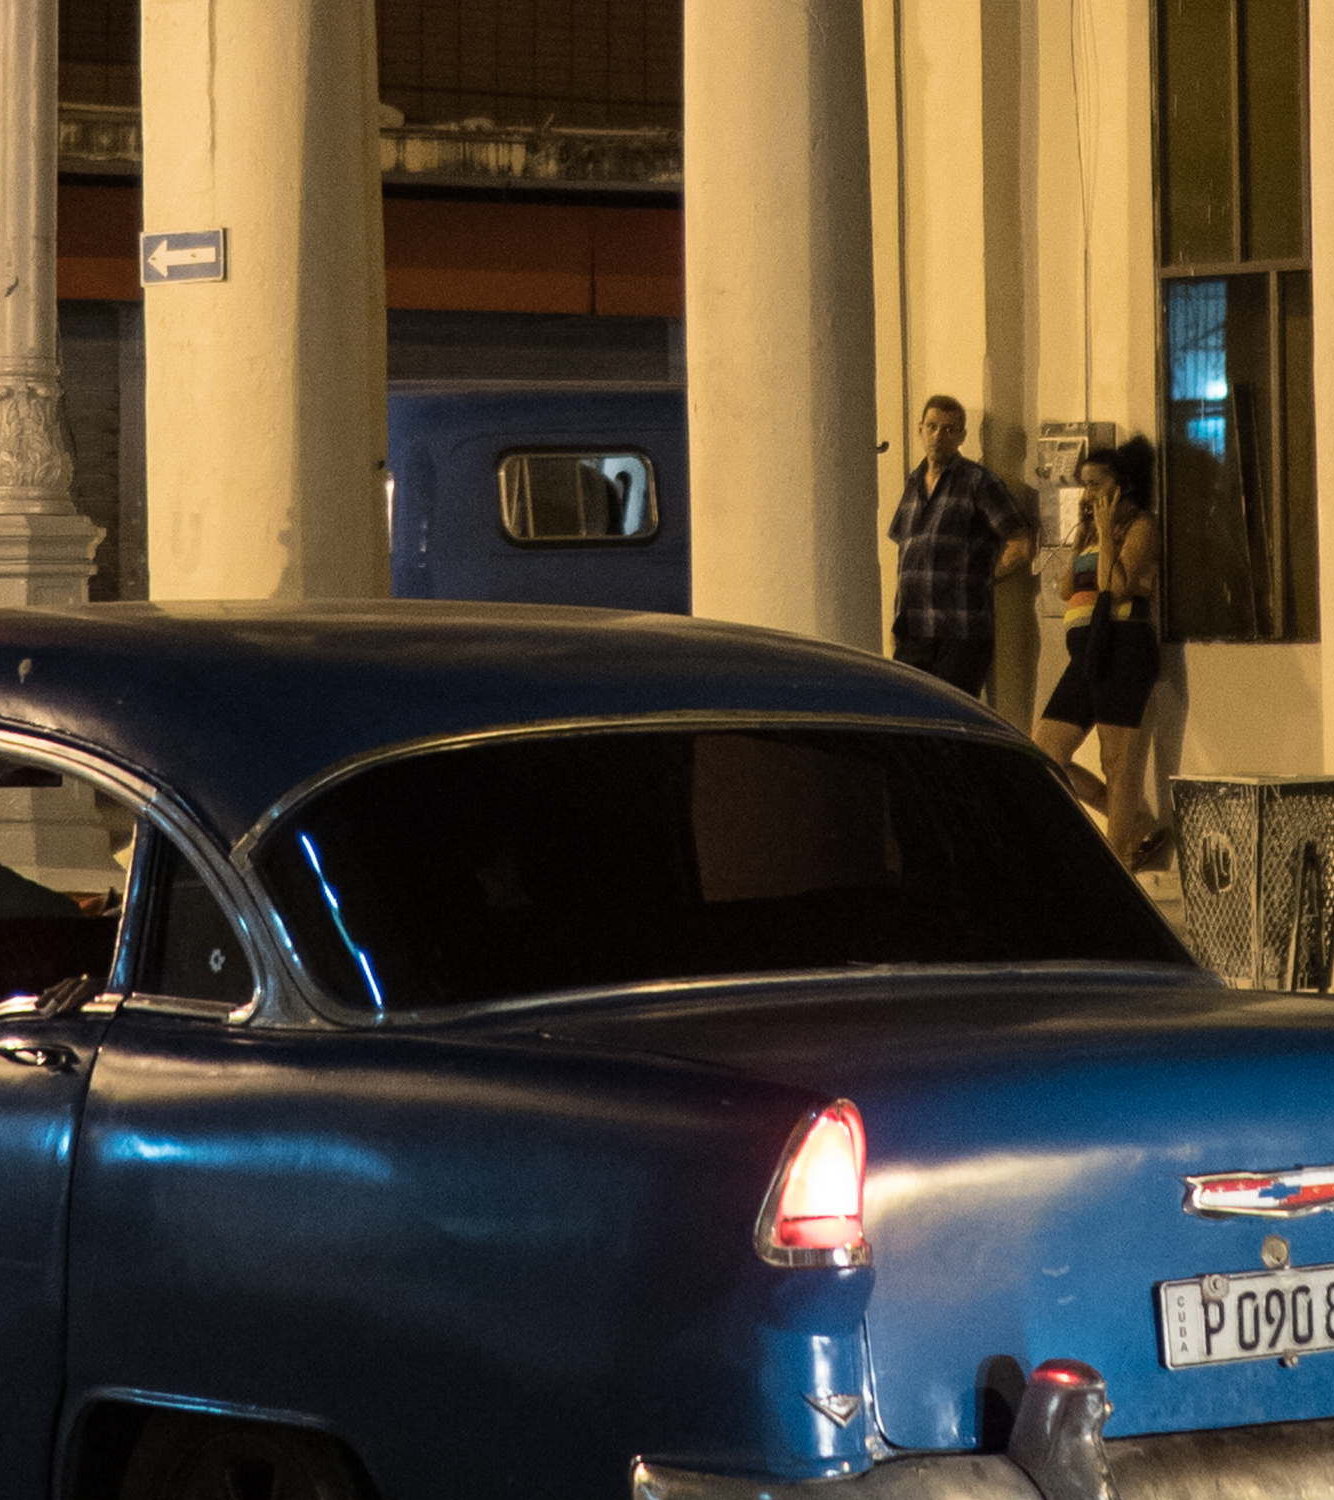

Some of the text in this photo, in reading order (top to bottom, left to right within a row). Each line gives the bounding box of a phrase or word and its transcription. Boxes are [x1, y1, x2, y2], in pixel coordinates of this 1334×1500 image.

[1177, 1295, 1189, 1353] CUBA
[1202, 1297, 1225, 1356] P
[1237, 1284, 1314, 1350] 090
